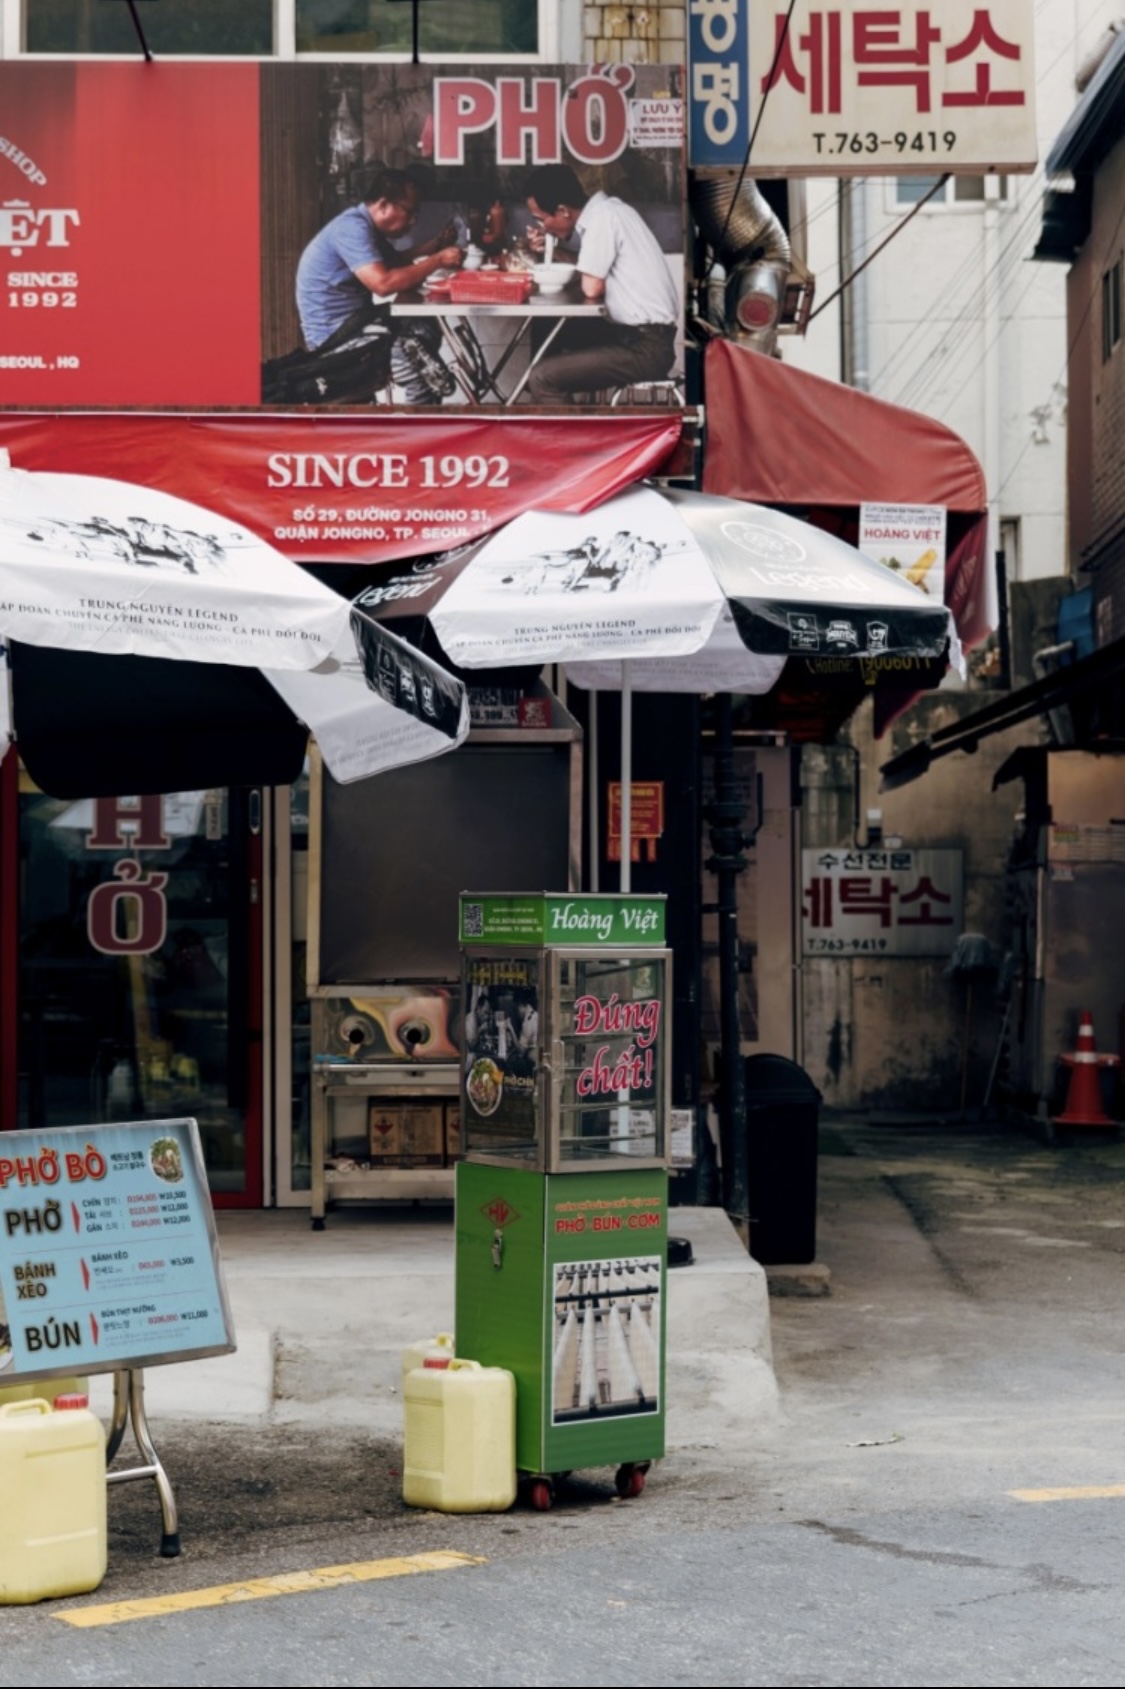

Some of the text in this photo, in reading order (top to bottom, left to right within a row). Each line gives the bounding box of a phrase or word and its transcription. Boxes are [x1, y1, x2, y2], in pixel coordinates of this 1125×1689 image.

[761, 9, 1025, 115] 세탁소
[813, 131, 957, 154] T.763-9419
[0, 136, 47, 186] SHOP
[7, 271, 78, 288] SINCE
[8, 291, 77, 308] 1992
[57, 355, 79, 369] HQ
[267, 452, 510, 488] SINCE 1992
[293, 504, 315, 522] SỐ
[317, 509, 343, 524] 29,
[404, 509, 467, 523] JONGNO
[470, 509, 492, 523] 31,
[274, 526, 319, 543] QUẬN
[321, 526, 390, 541] JONGNO,
[392, 527, 419, 540] TP.
[79, 598, 126, 612] TRUNG
[188, 608, 239, 623] LEGEND
[513, 626, 549, 636] TRUNG
[817, 853, 912, 871] 수선전문
[551, 903, 614, 940] Hoàng
[619, 907, 659, 934] Việt
[807, 938, 888, 950] T.763-9419
[573, 992, 661, 1048] Đúng
[0, 1143, 107, 1188] PHỞ BÒ
[5, 1197, 62, 1237] PHỞ
[555, 1211, 660, 1234] PHỞ BÚN CƠM
[13, 1260, 57, 1282] BÁNH
[24, 1316, 82, 1353] BÚN
